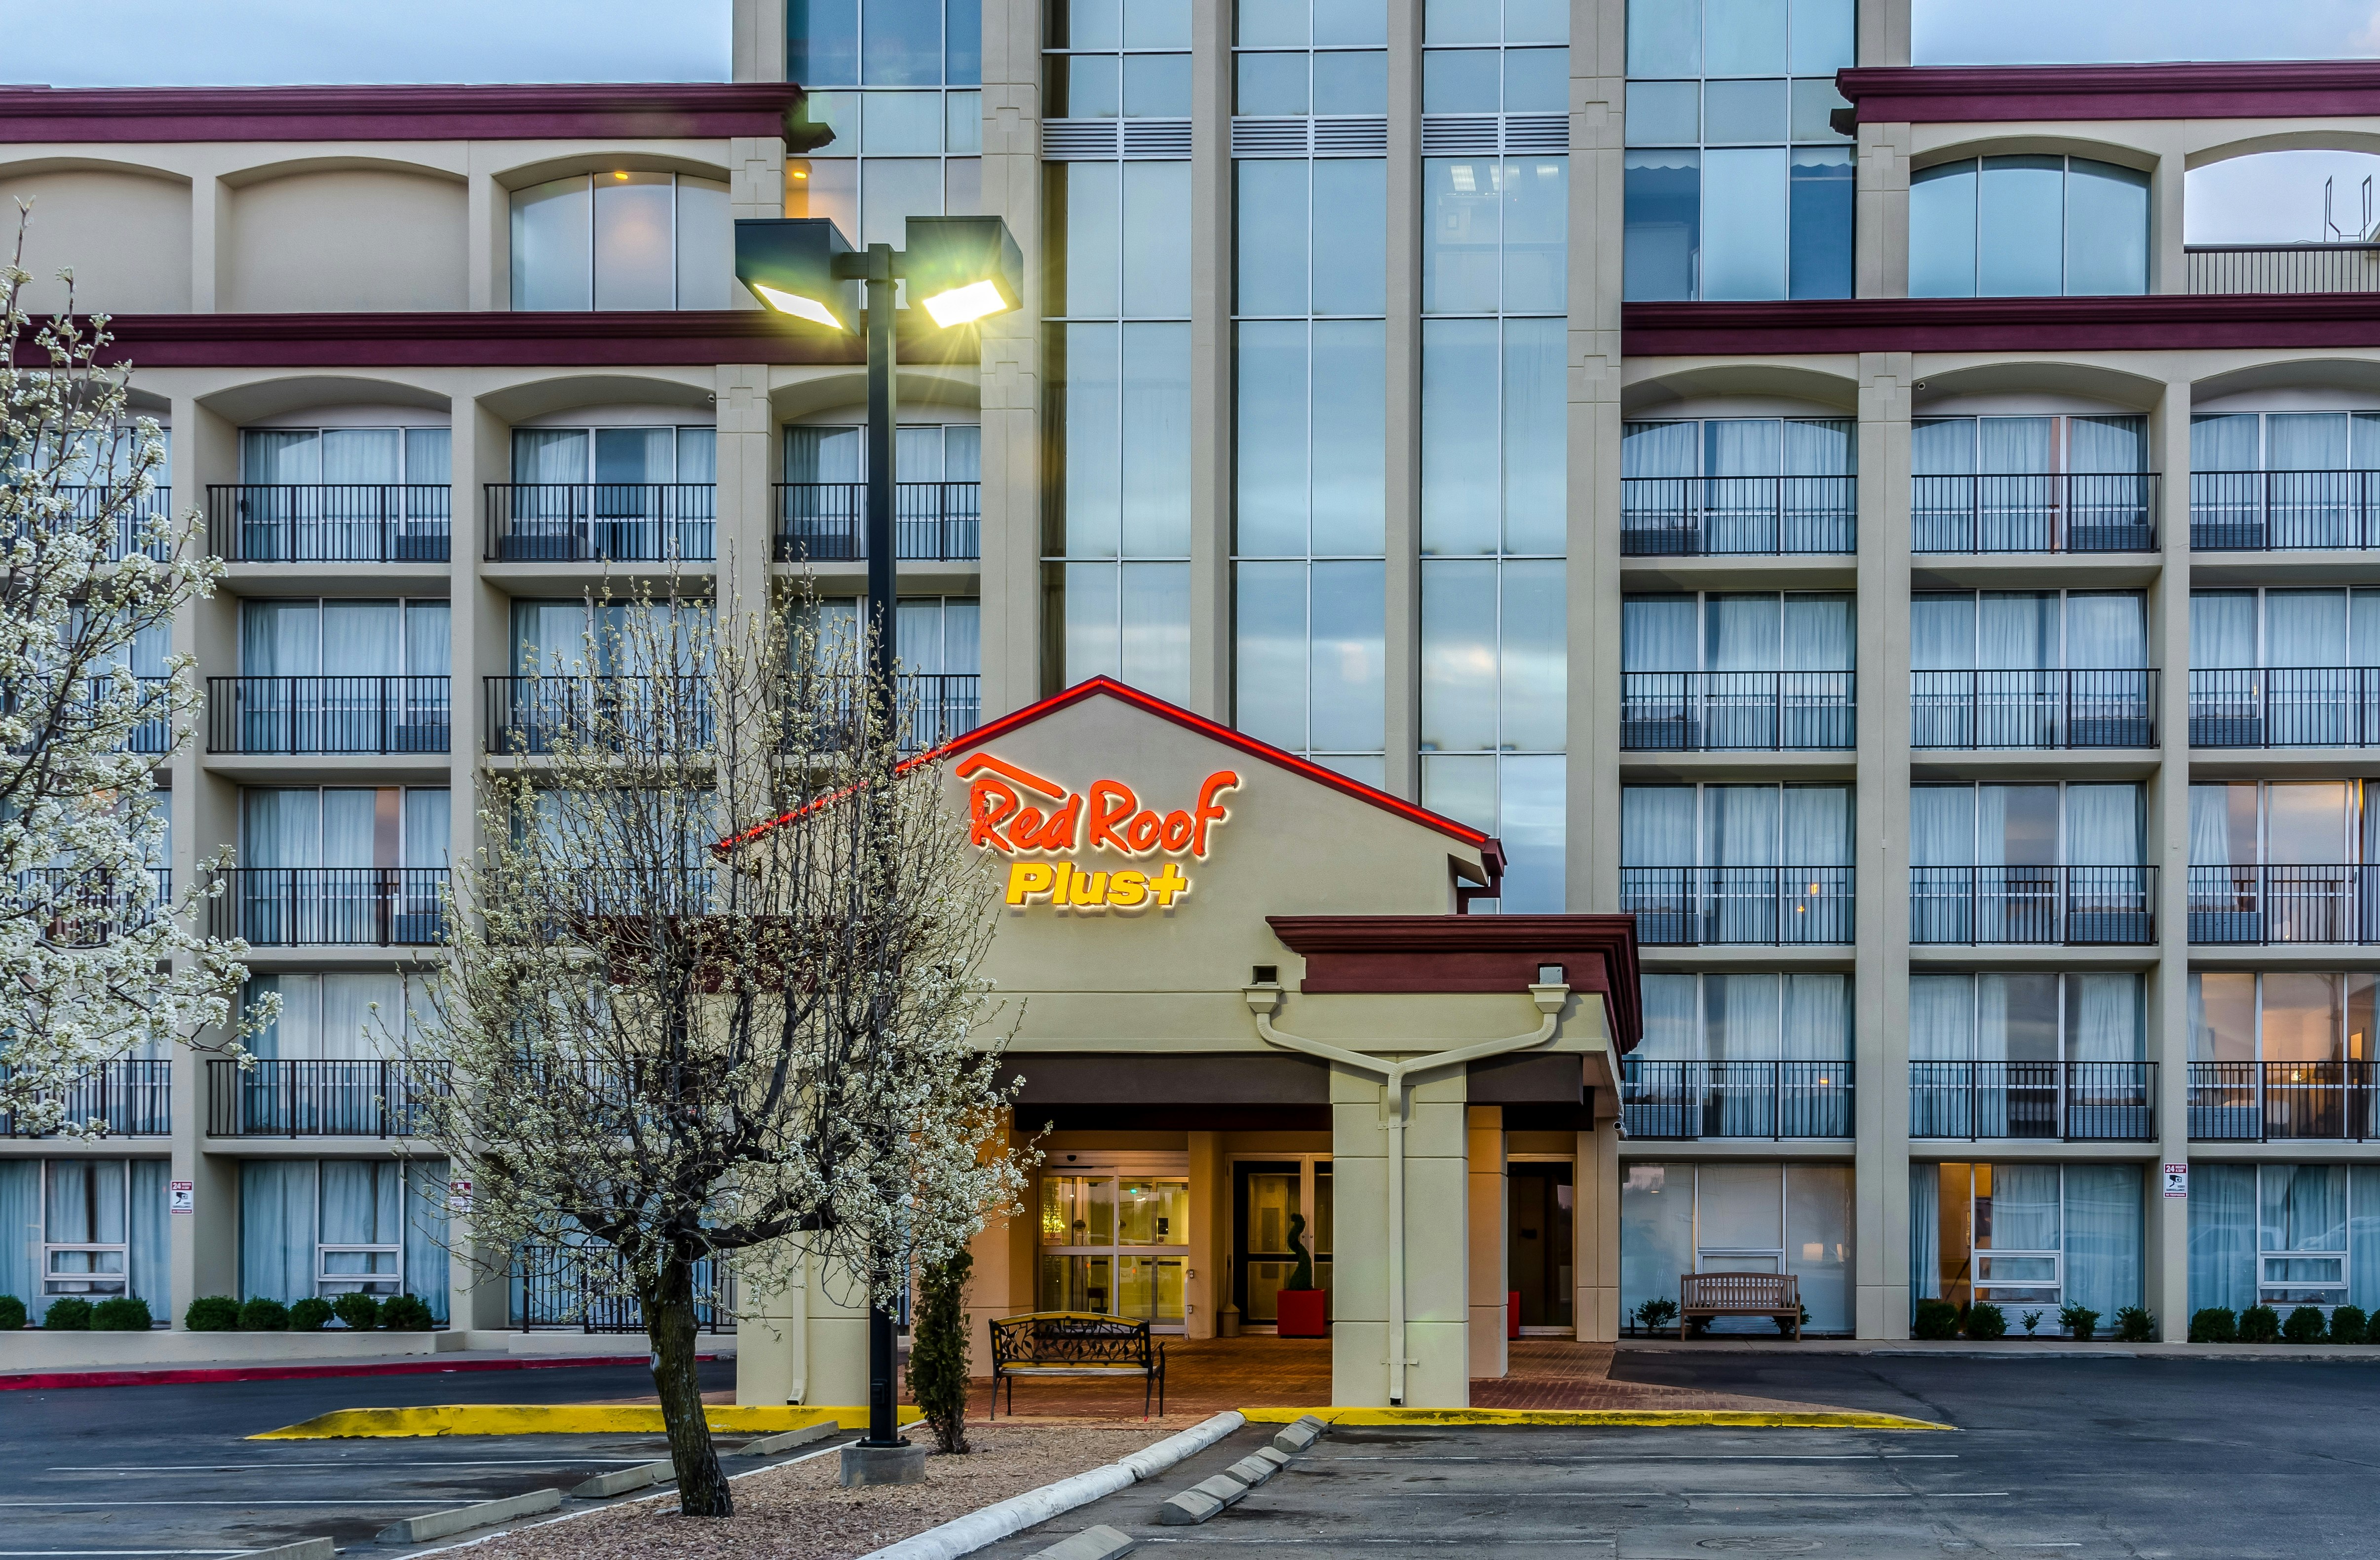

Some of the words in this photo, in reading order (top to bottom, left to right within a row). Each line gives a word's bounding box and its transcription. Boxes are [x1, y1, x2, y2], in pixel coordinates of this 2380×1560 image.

[971, 780, 1081, 852] Red
[1089, 771, 1236, 856] Roof
[1005, 861, 1186, 905] Plus+
